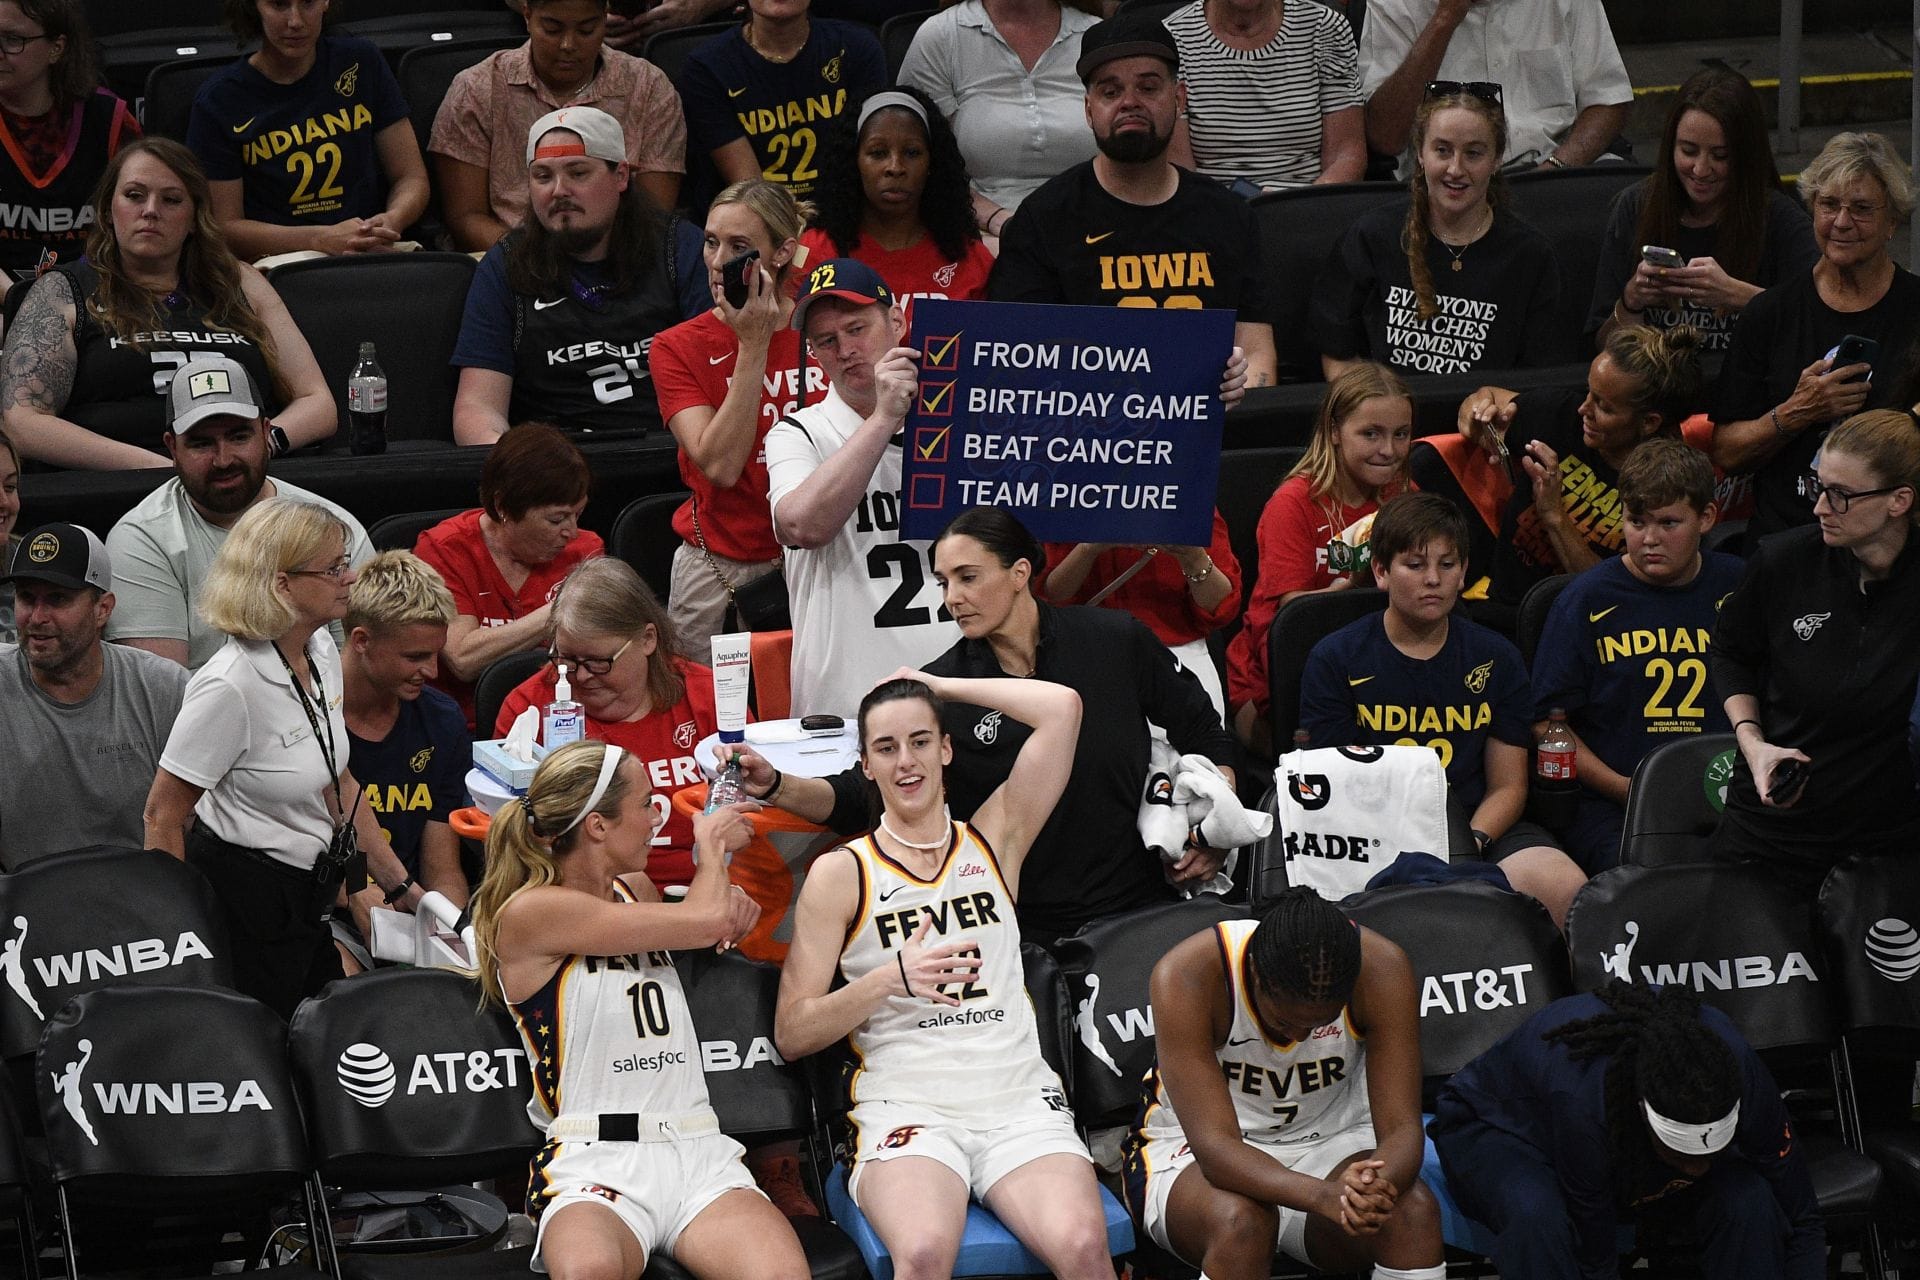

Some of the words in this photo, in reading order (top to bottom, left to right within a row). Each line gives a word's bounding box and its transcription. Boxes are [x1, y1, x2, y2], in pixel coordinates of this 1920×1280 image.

[242, 103, 373, 166] INDIANA
[286, 142, 344, 204] 22
[763, 127, 818, 182] 22
[809, 269, 836, 295] 22
[1100, 252, 1215, 290] IOWA
[1385, 285, 1498, 322] EVYONE
[973, 341, 1060, 370] FROM
[1071, 345, 1152, 373] IOWA
[1386, 326, 1485, 361] WOMEN'S
[967, 387, 1115, 419] BIRTHDAY
[1122, 394, 1210, 421] GAME
[962, 433, 1039, 462] BEAT
[1046, 437, 1174, 465] CANCER
[957, 479, 1040, 507] TEAM
[1050, 483, 1179, 510] PICTURE
[717, 649, 749, 663] Aquaphor
[1643, 658, 1707, 718] 22
[1357, 701, 1492, 733] NDIANA
[958, 863, 987, 878] Lilly
[33, 930, 214, 988] WNBA
[1640, 952, 1819, 993] WNBA
[1420, 963, 1533, 1018] AT&T
[626, 981, 670, 1039] 10
[1312, 1025, 1344, 1040] Lilly
[407, 1048, 525, 1095] AT&T
[1222, 1056, 1346, 1099] FEVER
[93, 1079, 274, 1115] WNBA
